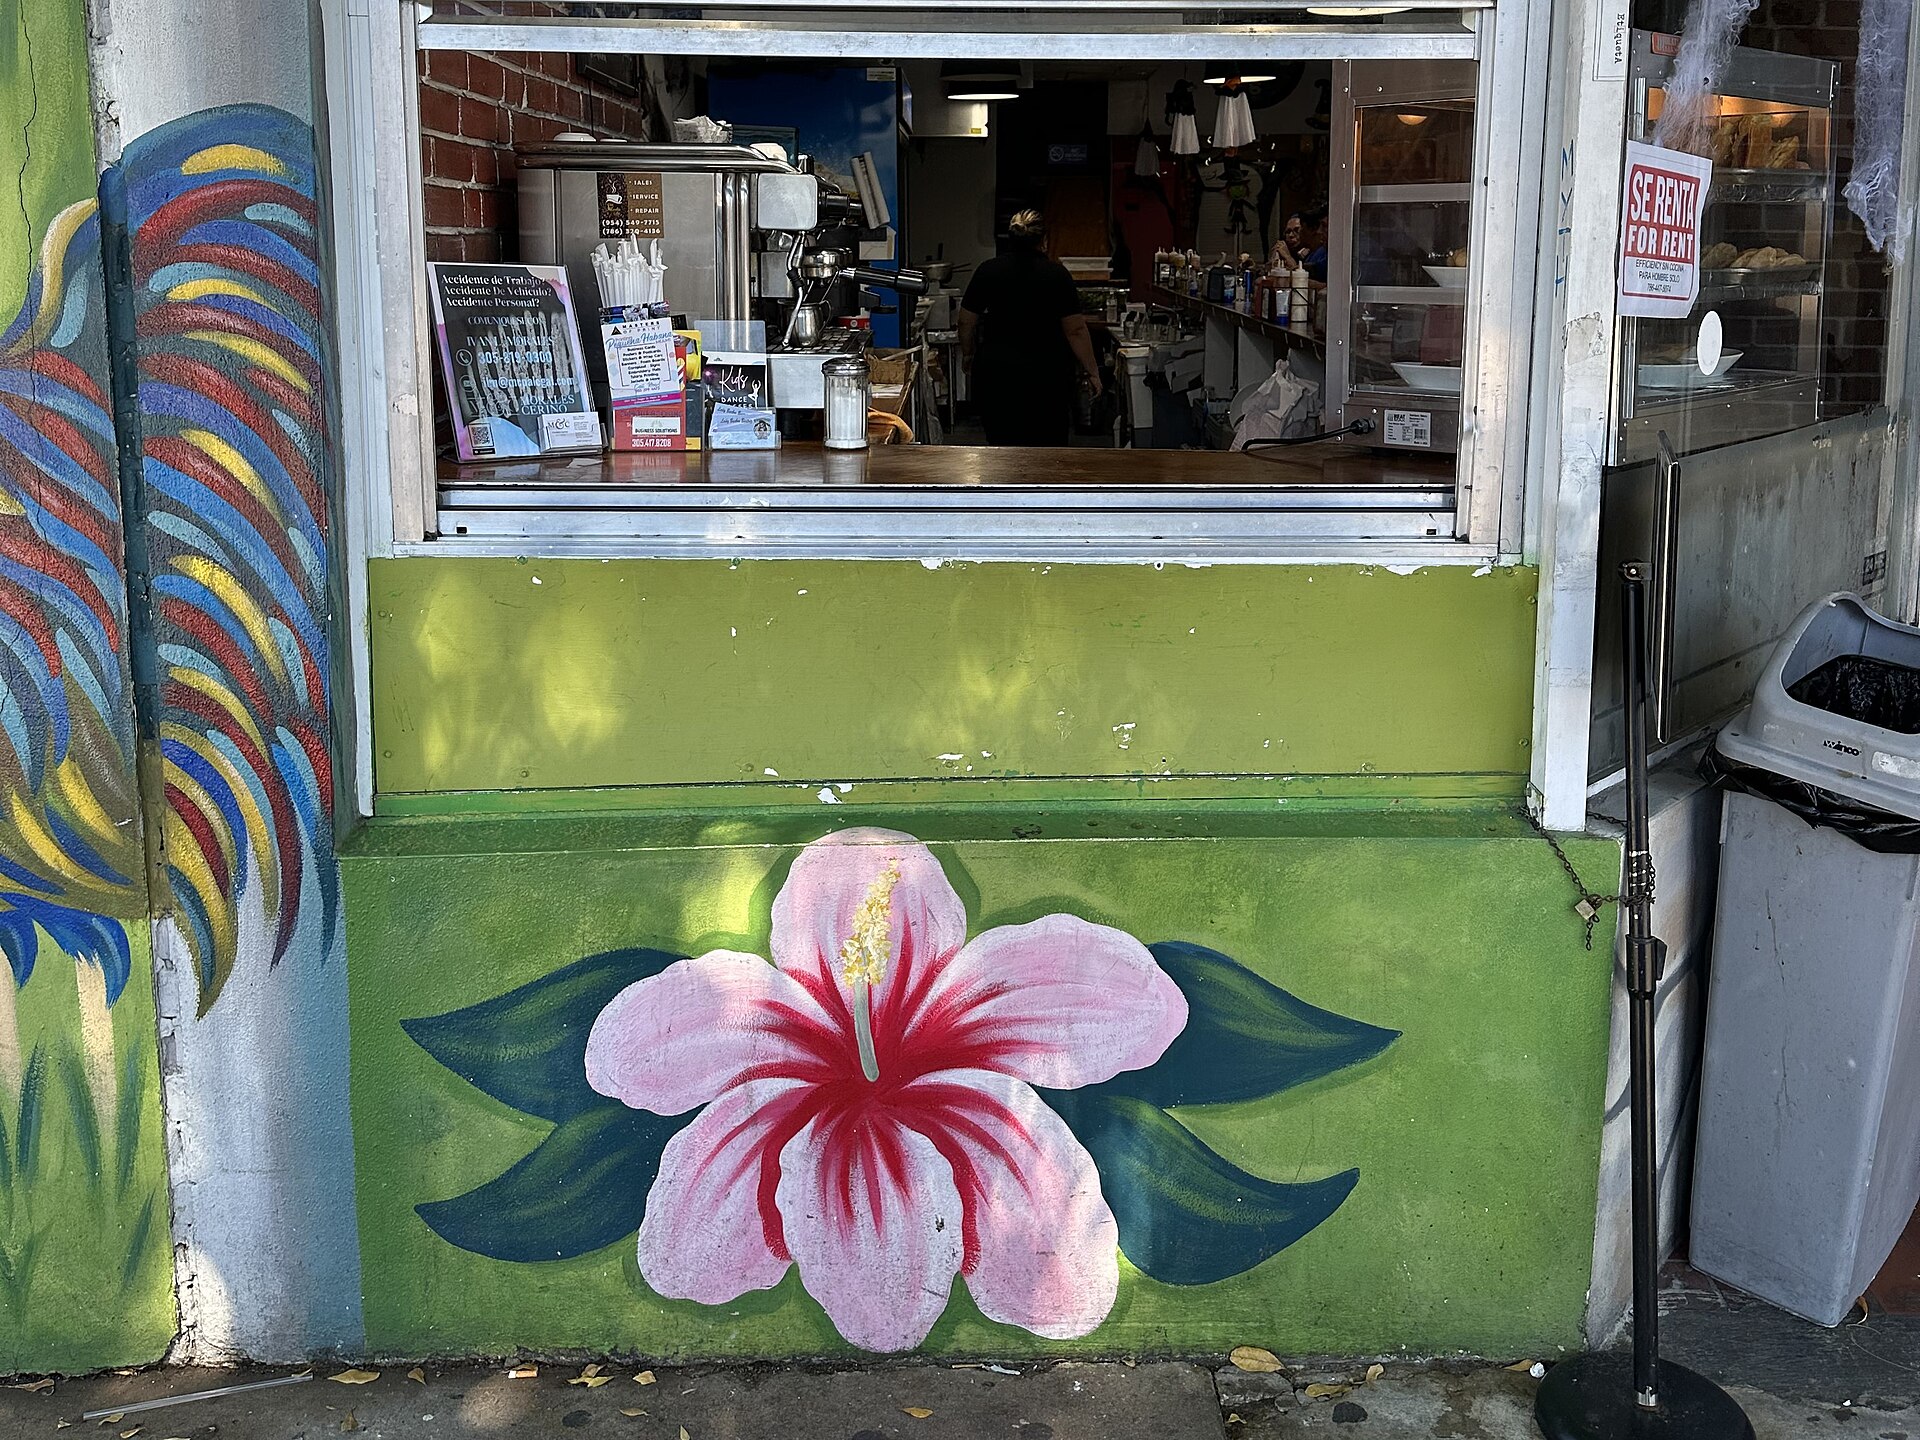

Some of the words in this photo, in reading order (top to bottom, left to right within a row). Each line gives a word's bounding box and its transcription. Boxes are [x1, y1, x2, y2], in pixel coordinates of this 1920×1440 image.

[1631, 170, 1654, 222] SE
[1654, 175, 1695, 230] RENTA
[602, 219, 623, 227] (954)
[602, 227, 623, 236] (786)
[1627, 224, 1658, 255] FOR
[1660, 229, 1694, 259] RENT
[1635, 259, 1662, 270] EFFICIENCY
[442, 274, 489, 285] Accidente
[490, 275, 503, 285] de
[503, 275, 545, 287] Trabajo?
[1638, 270, 1652, 280] PARA
[1652, 273, 1669, 282] HOMBRE
[443, 285, 492, 296] Accidente
[493, 286, 506, 296] De
[446, 296, 494, 307] Accidente
[494, 297, 540, 308] Personal?
[622, 321, 660, 329] MASTERS
[640, 331, 673, 344] Habana
[718, 366, 749, 396] Kids
[521, 394, 575, 406] MORALES
[521, 404, 568, 415] CERINO
[631, 438, 672, 447] 305.417.8208
[1823, 740, 1860, 757] winco
